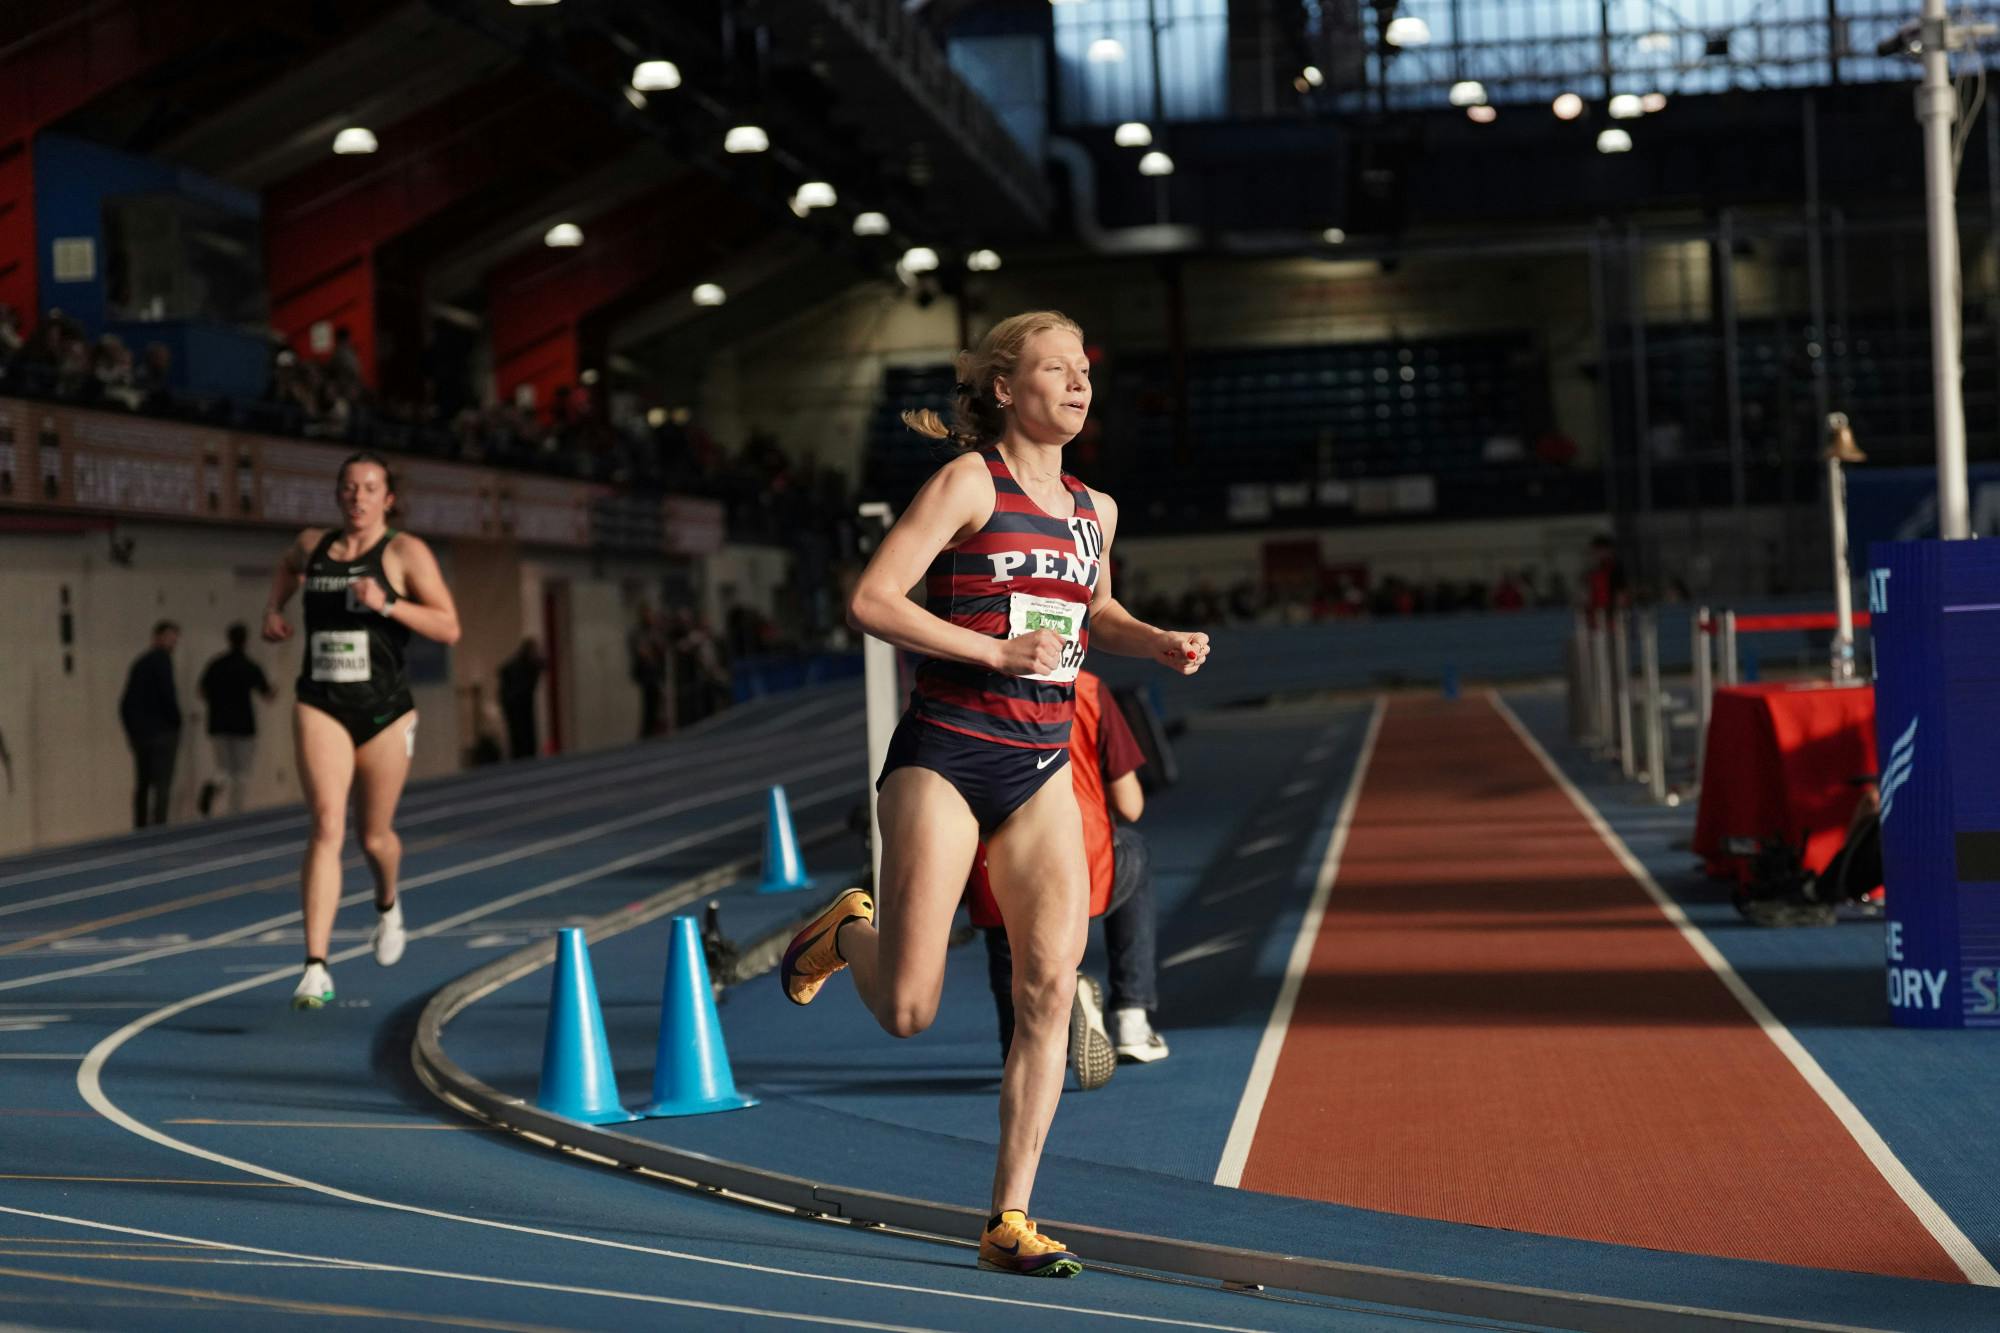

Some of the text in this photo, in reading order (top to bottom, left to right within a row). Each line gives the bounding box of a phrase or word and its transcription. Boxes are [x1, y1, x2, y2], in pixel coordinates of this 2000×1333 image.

[1072, 519, 1100, 560] 10
[1886, 921, 1904, 961] E
[1888, 967, 1948, 1010] ORY
[1971, 966, 2000, 1014] S
